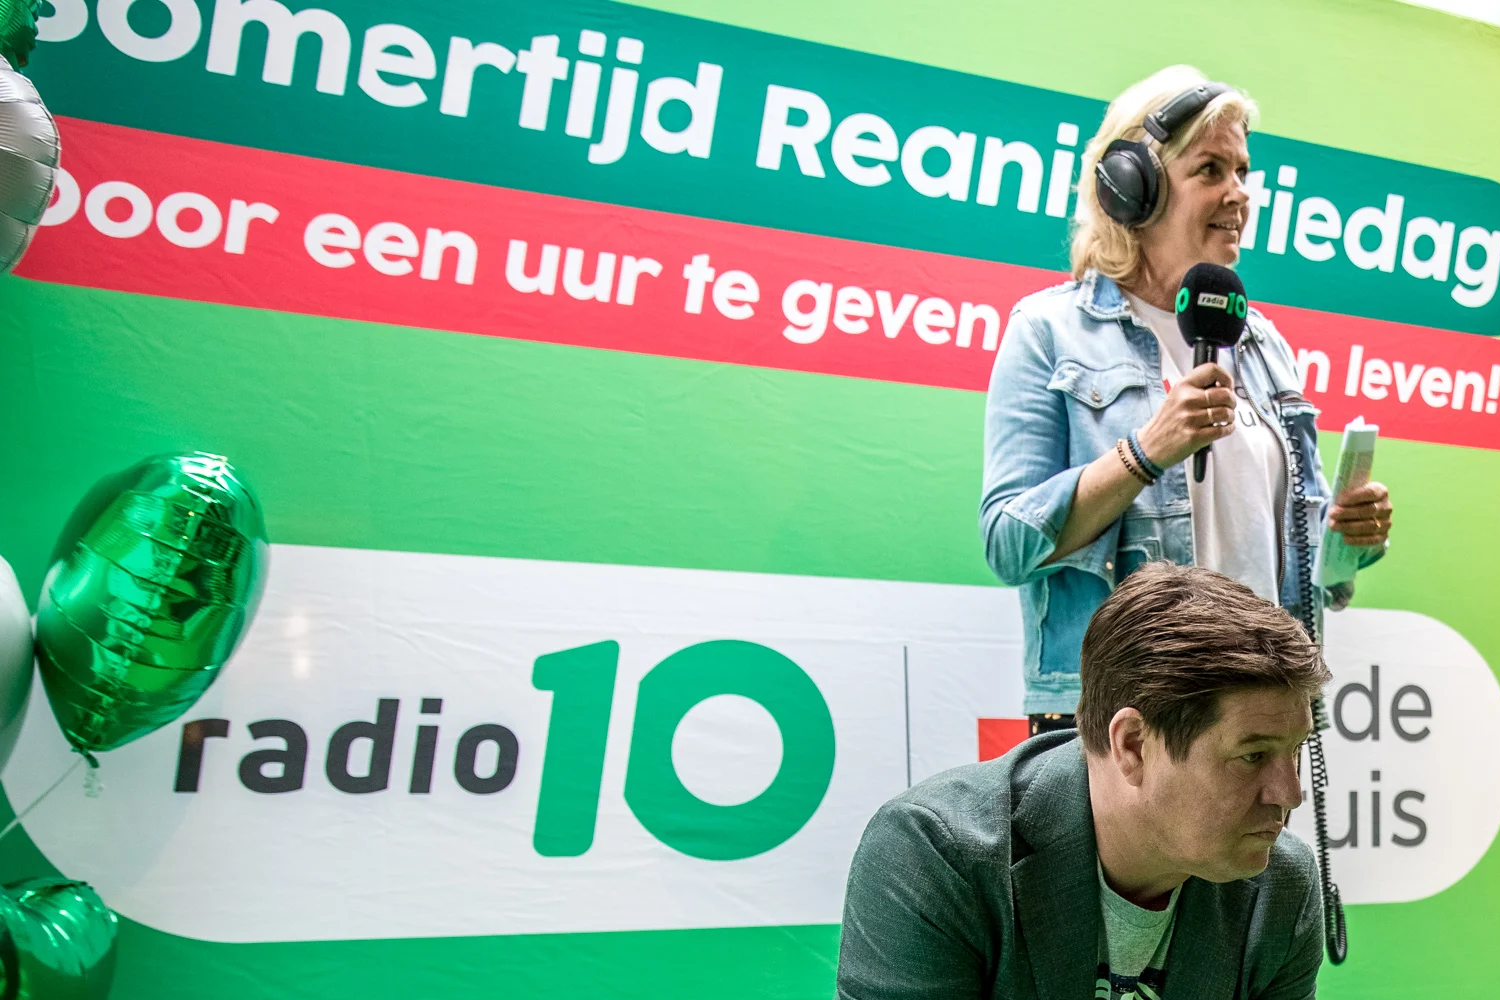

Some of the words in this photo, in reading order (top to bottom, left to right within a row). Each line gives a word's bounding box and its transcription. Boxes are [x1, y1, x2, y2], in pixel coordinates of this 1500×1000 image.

[303, 212, 478, 286] een
[504, 238, 663, 306] uur
[683, 253, 760, 320] te
[781, 278, 1001, 351] geven
[1201, 296, 1225, 307] radio
[173, 698, 520, 794] radio
[531, 639, 836, 862] 10
[1332, 664, 1433, 743] de
